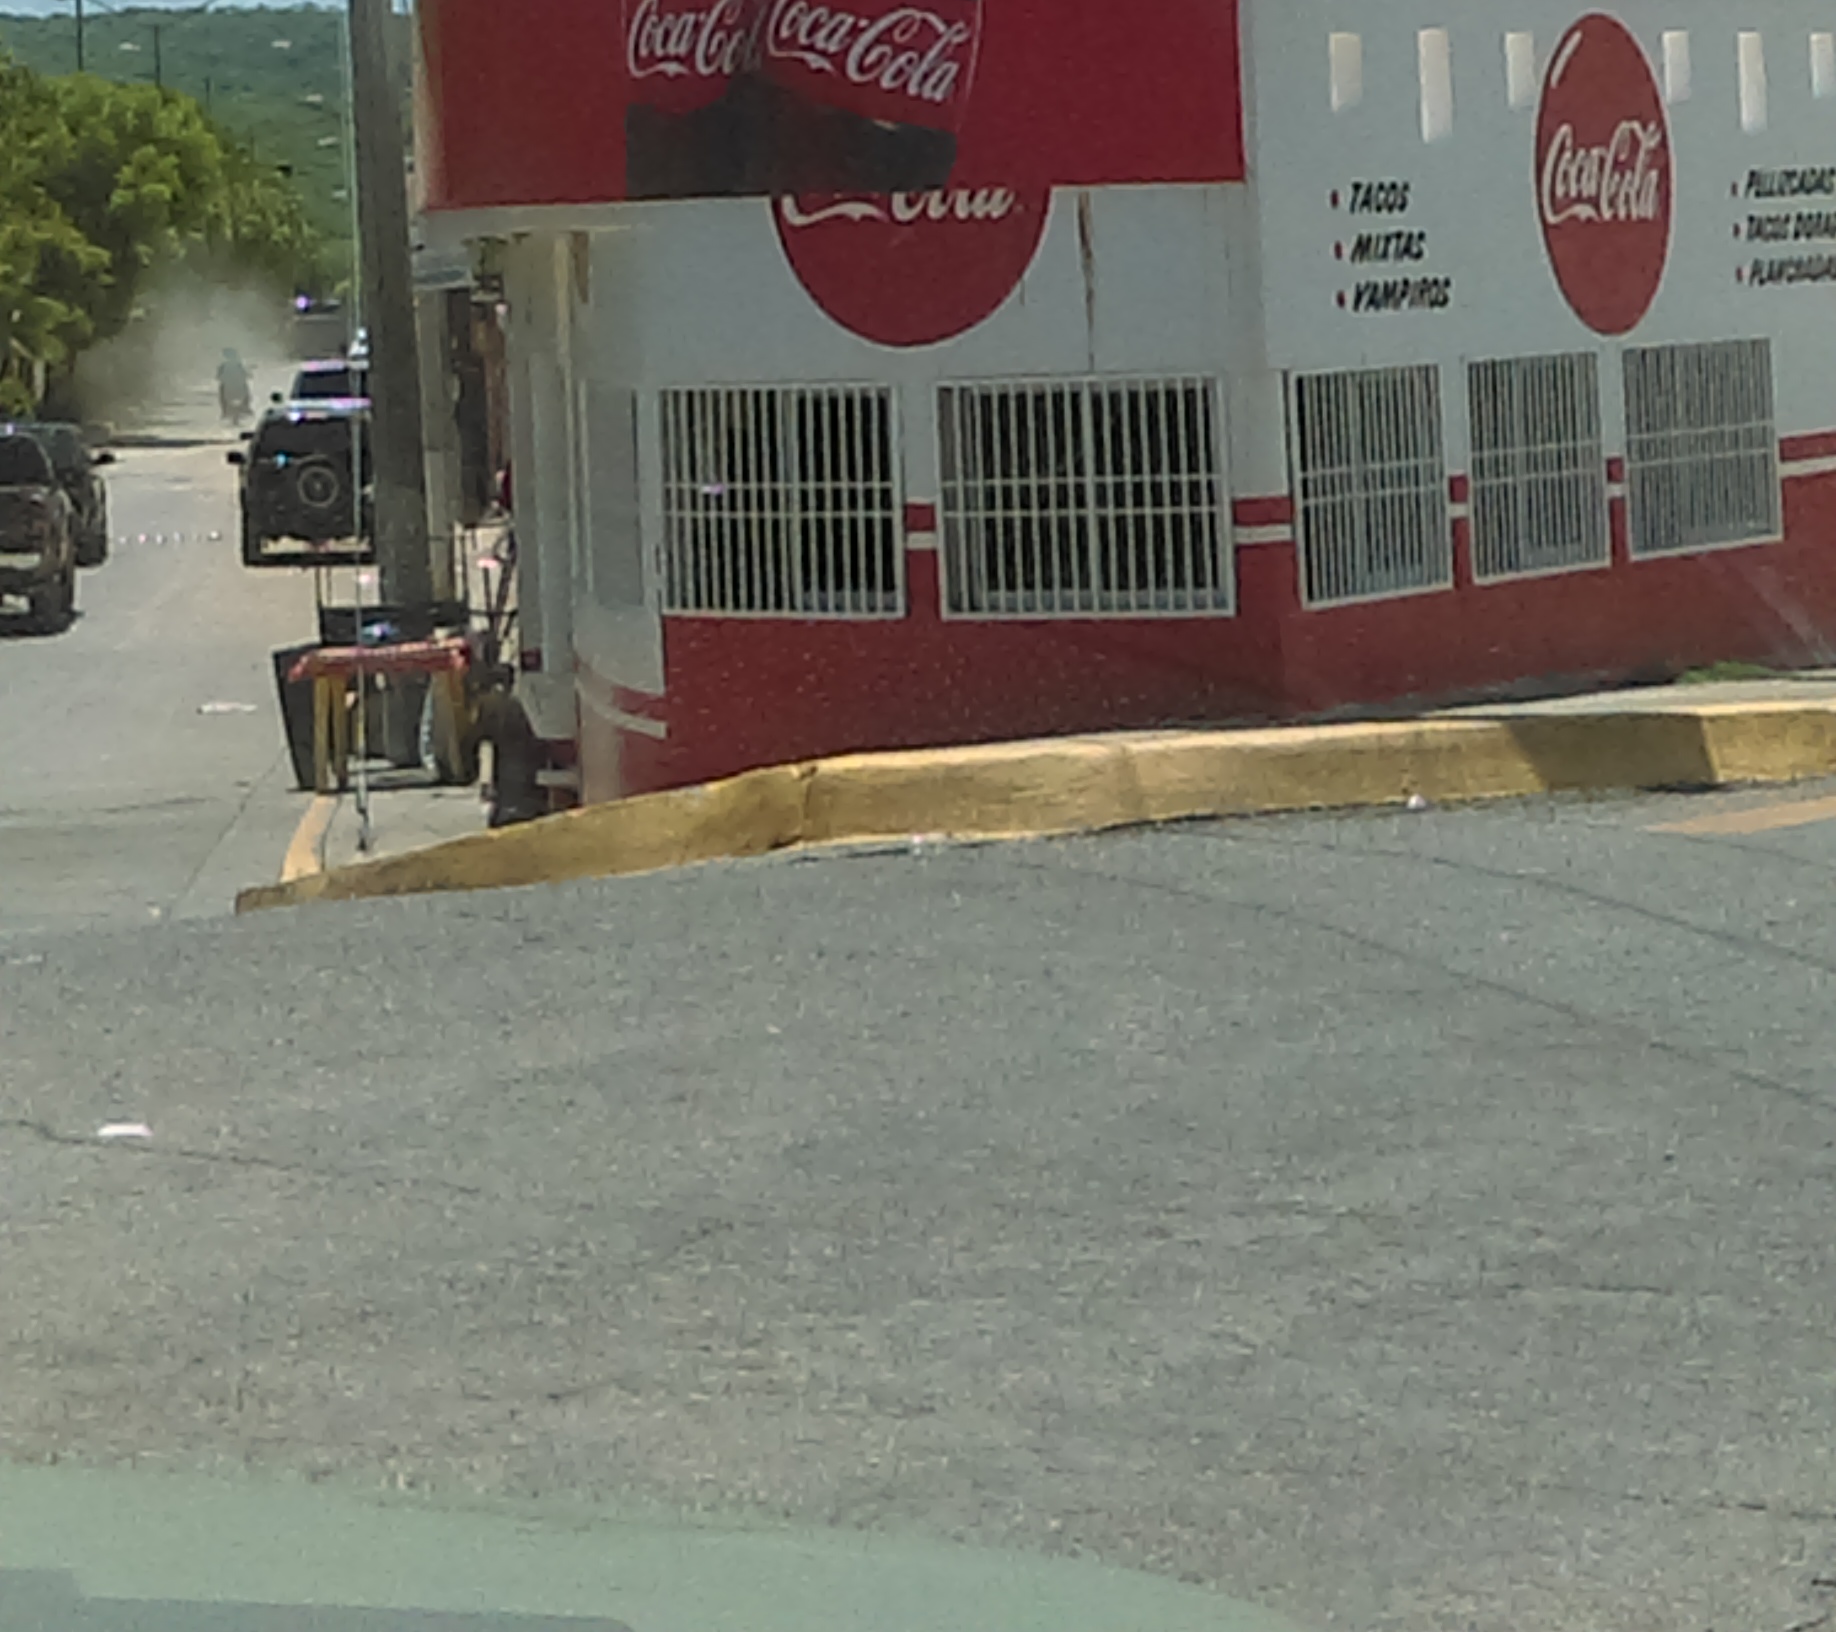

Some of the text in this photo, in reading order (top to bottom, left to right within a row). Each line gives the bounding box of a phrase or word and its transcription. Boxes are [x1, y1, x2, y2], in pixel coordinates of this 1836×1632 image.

[1350, 181, 1410, 214] TACOS
[1351, 230, 1426, 264] MIXTAS
[1353, 276, 1450, 313] VAMPIROS
